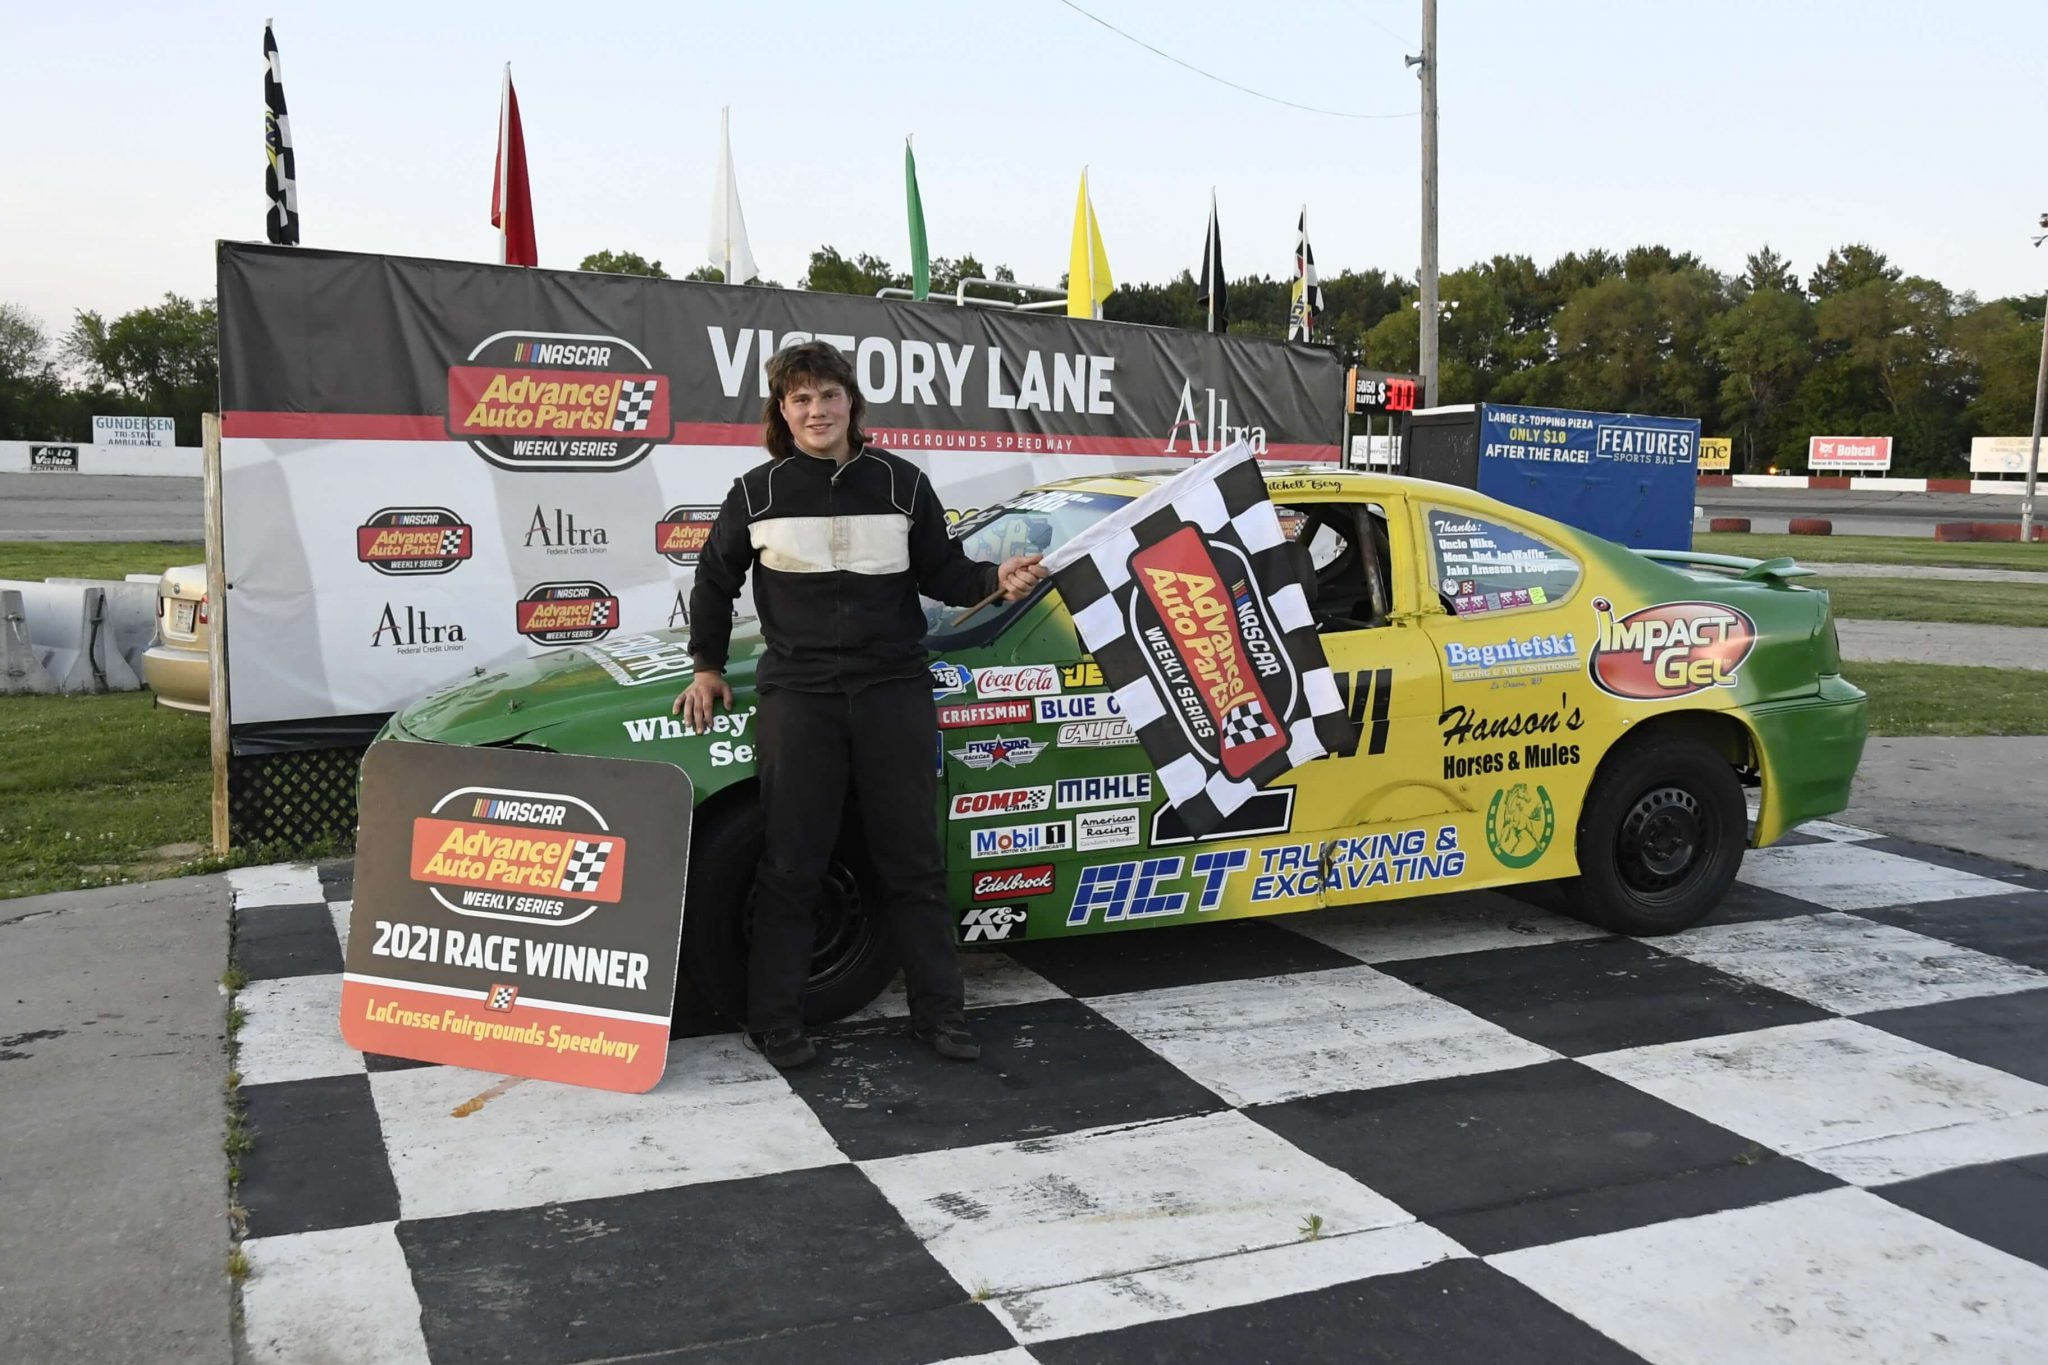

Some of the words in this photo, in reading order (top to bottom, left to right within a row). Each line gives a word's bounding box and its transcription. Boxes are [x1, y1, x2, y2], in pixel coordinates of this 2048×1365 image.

[538, 344, 611, 366] NASCAR
[707, 326, 975, 407] VIORY
[988, 347, 1115, 414] LANE
[479, 374, 610, 406] Advance
[96, 417, 173, 431] GUNDERSEN
[464, 403, 533, 429] Auto
[534, 405, 604, 430] Parts
[1488, 412, 1518, 422] LARGE
[1519, 415, 1566, 427] 2-TOPPING
[1567, 418, 1593, 429] PIZZA
[108, 439, 162, 447] AMBULANCE
[114, 431, 155, 439] TRI-STATE
[872, 432, 987, 448] FAIRGROUNDS
[997, 436, 1073, 450] SPEEDWAY
[1509, 428, 1540, 442] ONLY
[1543, 429, 1567, 444] $10
[1601, 429, 1690, 456] FEATURES
[513, 441, 569, 456] WEEKLY
[570, 441, 618, 456] SERIES
[1485, 443, 1524, 459] AFTER
[1528, 446, 1551, 461] THE
[1553, 448, 1589, 463] RACE!
[1837, 444, 1876, 457] Bobcat
[1613, 453, 1652, 464] SPORTS
[1655, 456, 1675, 465] BAR
[1268, 480, 1305, 491] itchell
[1306, 480, 1343, 493] Berg
[403, 514, 439, 525] NASCAR
[523, 504, 609, 547] Altra
[1434, 520, 1482, 533] Thanks:
[374, 530, 438, 545] Advance
[670, 526, 711, 538] Advan
[367, 543, 402, 556] Auto
[402, 544, 435, 556] Parts
[570, 547, 588, 555] Credit
[664, 538, 690, 549] Auto
[1438, 539, 1468, 550] Uncle
[1469, 538, 1497, 549] Mike,
[391, 560, 419, 569] WEEKLY
[419, 560, 443, 568] SERIES
[1446, 565, 1469, 576] Jake
[1472, 564, 1513, 575] Arneson
[557, 588, 590, 598] NASCAR
[532, 604, 589, 617] Advance
[370, 601, 466, 647] Altra
[526, 616, 556, 628] Auto
[556, 616, 587, 627] Parts
[546, 631, 571, 639] WEEKLY
[571, 630, 594, 638] SERIES
[1144, 567, 1197, 635] Auto
[1184, 636, 1229, 709] Parts
[1176, 572, 1245, 694] Advance
[1237, 601, 1281, 678] NASCAR
[397, 647, 421, 655] Federal
[1445, 633, 1577, 669] Bagniefski
[977, 667, 1055, 693] Coca-Cola
[1064, 663, 1104, 687] JE
[1502, 667, 1518, 675] AIR
[1145, 626, 1188, 684] WEEKLY
[1177, 687, 1215, 739] SERIES
[943, 706, 1025, 723] CRAFTSMAN
[1041, 697, 1096, 720] BLUE
[622, 706, 757, 742] Whiey'
[1438, 692, 1584, 746] Hanson's
[969, 742, 996, 753] FIVE
[1002, 740, 1029, 749] STAR
[1443, 751, 1503, 780] Horses
[1508, 750, 1520, 770] &
[1525, 743, 1580, 769] Mules
[1058, 775, 1149, 803] MAHLE
[955, 791, 1028, 814] COMP
[1004, 802, 1039, 812] CAMS
[494, 801, 566, 826] NASCAR
[1081, 814, 1136, 826] American
[977, 827, 1039, 851] Mobil
[1087, 826, 1130, 837] Racing
[438, 827, 562, 865] Advance
[1259, 828, 1427, 873] TRUCKING
[1434, 826, 1459, 852] &
[422, 853, 484, 880] Auto
[485, 859, 553, 888] Parts
[1250, 851, 1467, 903] EXCAVATING
[975, 871, 1052, 895] Edelbrock
[1066, 847, 1252, 927] ACT
[463, 890, 516, 911] WEEKLY
[515, 897, 564, 916] SERIES
[372, 920, 440, 963] 2021
[444, 930, 520, 973] RACE
[524, 940, 649, 990] WINNER
[365, 998, 440, 1031] LaCrosse
[441, 1009, 545, 1047] Fairgrounds
[546, 1025, 640, 1063] Speedway
